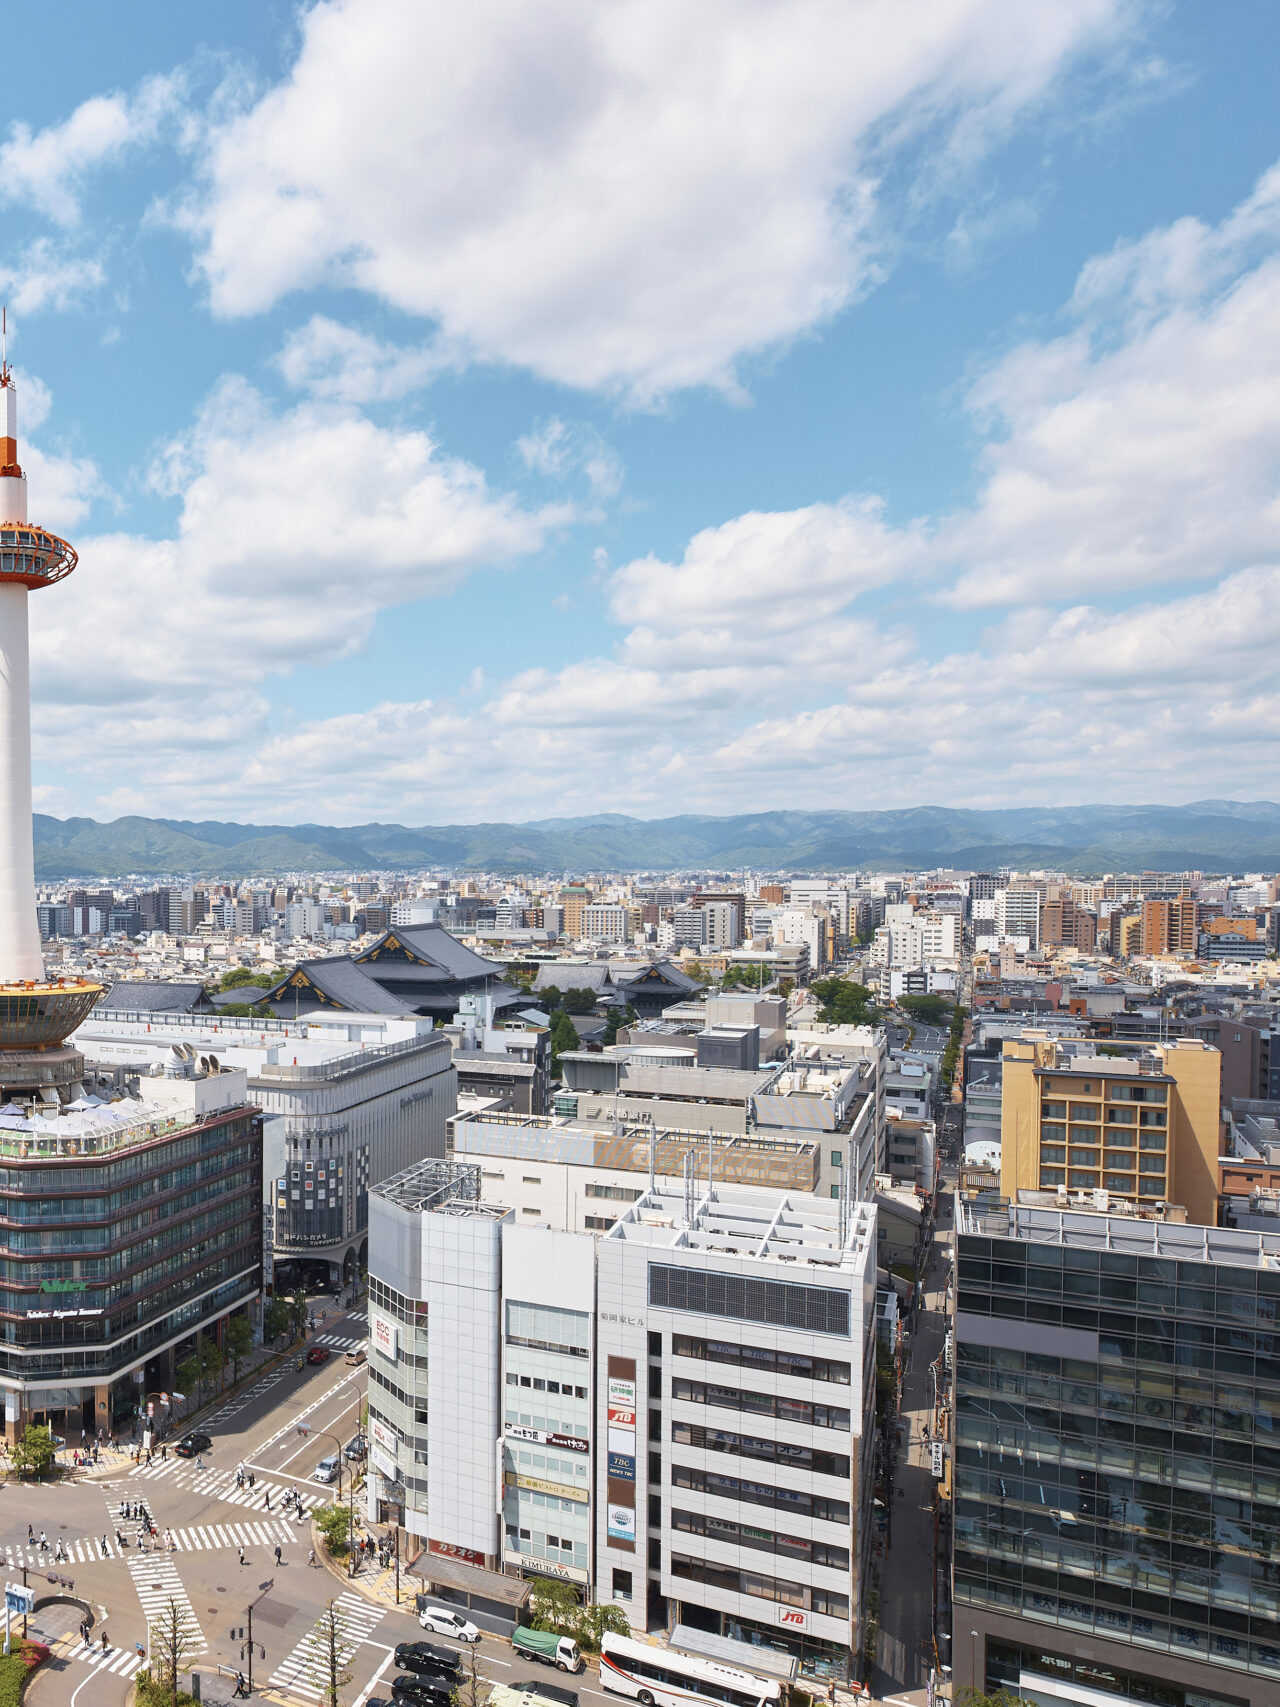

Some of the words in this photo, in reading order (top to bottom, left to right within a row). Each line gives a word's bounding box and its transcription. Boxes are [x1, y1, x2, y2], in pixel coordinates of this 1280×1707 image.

[38, 1279, 91, 1294] Nidec
[376, 1320, 390, 1337] ECC
[611, 1411, 632, 1422] JTB
[614, 1457, 630, 1467] TBC
[438, 1542, 476, 1559] カラオケ
[521, 1558, 570, 1578] KIMURAYA
[781, 1611, 804, 1625] JTB
